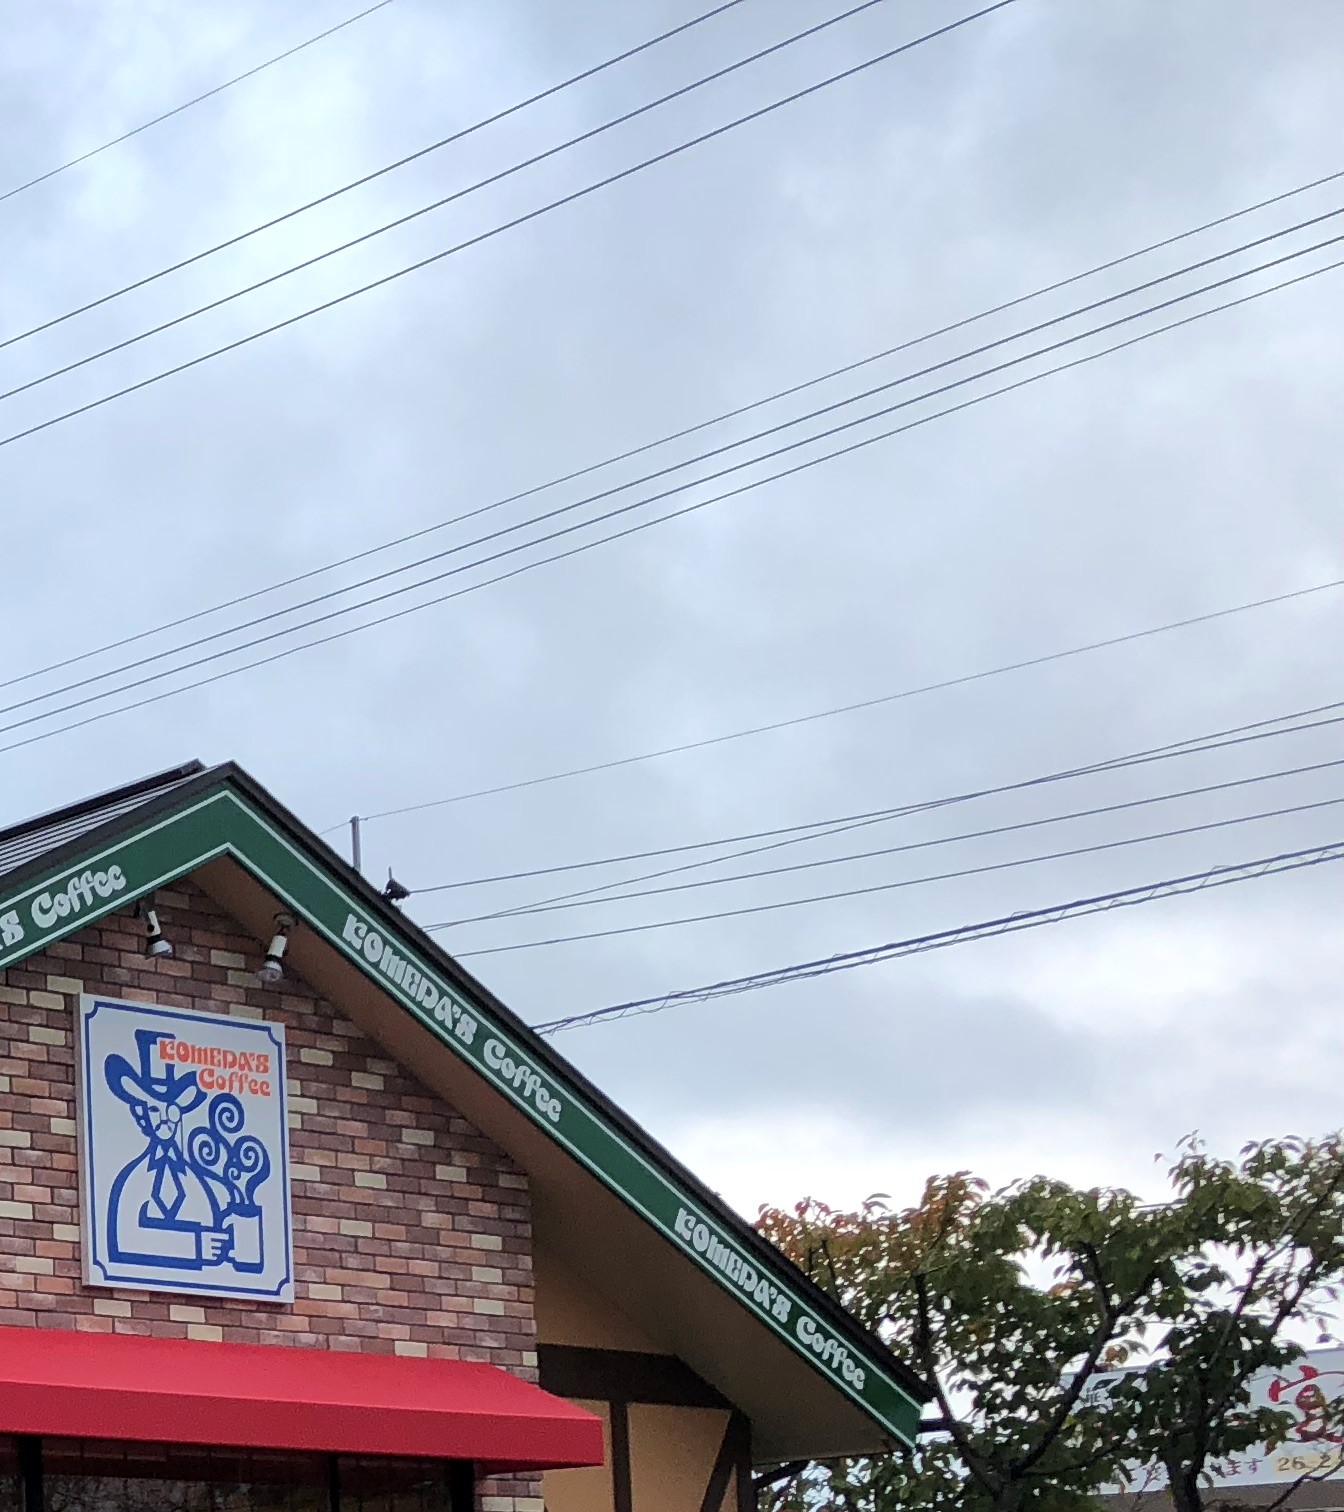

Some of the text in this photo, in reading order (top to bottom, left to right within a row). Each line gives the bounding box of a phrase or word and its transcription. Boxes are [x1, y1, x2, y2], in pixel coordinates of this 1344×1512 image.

[31, 864, 127, 929] Coffee
[342, 913, 562, 1123] KOMEDA'S Coffee
[159, 1039, 270, 1074] KOMEDA'S
[198, 1068, 271, 1097] Coffee
[674, 1207, 866, 1390] KOMEDA'S Coffee
